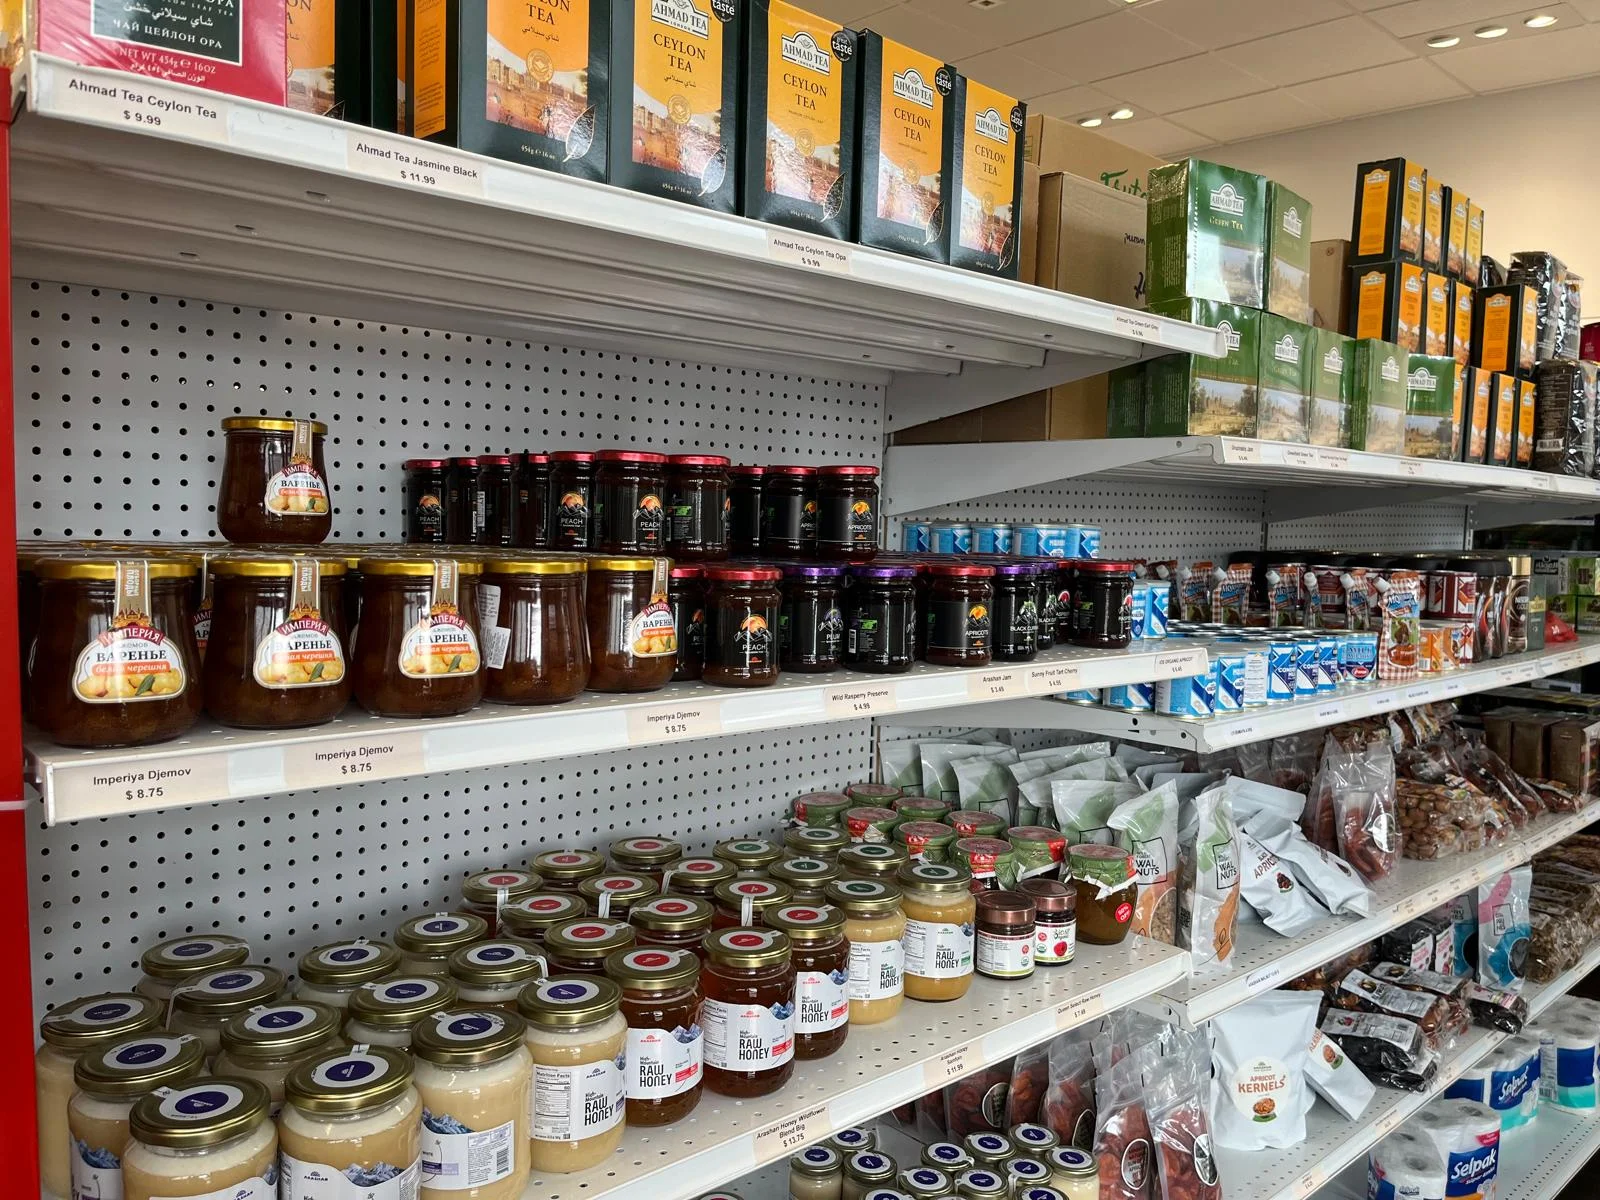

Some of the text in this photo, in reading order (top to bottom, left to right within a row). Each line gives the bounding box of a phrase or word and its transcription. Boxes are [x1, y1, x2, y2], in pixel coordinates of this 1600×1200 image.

[524, 3, 556, 26] TEA
[653, 3, 708, 32] AHMAD TEA
[113, 19, 139, 32] ЧАЙ
[144, 26, 196, 43] ЦЕЙЛОН
[653, 33, 707, 61] CEYLON
[831, 41, 853, 56] taste
[141, 51, 156, 62] WT
[783, 42, 829, 69] AHMAD TEA
[667, 54, 693, 73] TEA
[783, 73, 828, 98] CEYLON
[935, 76, 952, 90] taste
[69, 78, 217, 119] Ahmad Tea Ceylon Tea
[894, 80, 932, 102] AHMAD TEA
[794, 93, 817, 112] TEA
[123, 109, 162, 126] $ 9.99
[893, 107, 931, 130] CEYLON
[903, 125, 921, 143] TEA
[976, 117, 1008, 139] AHMAD TEA
[356, 143, 478, 179] Ahmad Tea Jasmine Black
[975, 144, 1006, 165] CEYLON
[983, 162, 998, 177] TEA
[400, 169, 436, 186] $ 11.99
[773, 238, 847, 263] Ahmad Tea Ceylon Tea Opa
[560, 517, 583, 525] PEACH
[283, 619, 328, 635] ИМПЕРИЯ
[1002, 674, 1012, 682] Jam
[1032, 670, 1044, 678] Sunny
[1045, 669, 1055, 677] Fruit
[1064, 667, 1078, 677] Cherry
[868, 690, 888, 698] Preserve
[647, 710, 701, 722] Imperiya Djemov
[665, 724, 687, 734] $ 8.75
[315, 745, 394, 762] Imperiya Djemov
[341, 763, 372, 775] $ 8.75
[93, 767, 191, 787] Imperiya Djemov
[126, 787, 164, 801] $ 8.75
[1136, 860, 1156, 868] WAL
[1136, 867, 1160, 876] NUTS
[1219, 861, 1234, 871] WAL
[1220, 868, 1237, 881] NUTS
[935, 959, 959, 969] HONEY
[936, 951, 955, 962] RAW
[880, 969, 896, 980] RAW
[880, 977, 900, 990] HONEY
[801, 1002, 823, 1014] RAW
[801, 1010, 829, 1024] HONEY
[739, 1038, 762, 1049] RAW
[739, 1047, 769, 1060] HONEY
[640, 1064, 664, 1076] RAW
[639, 1073, 672, 1088] HONEY
[1250, 1074, 1276, 1082] APRICOT
[1238, 1079, 1285, 1093] KERNELS
[585, 1096, 608, 1114] RAW
[584, 1104, 614, 1126] HONEY
[757, 1106, 826, 1140] Arashan Honey Wildflower
[779, 1124, 805, 1138] Blend Big
[789, 1133, 805, 1145] 13.75
[1451, 1148, 1497, 1180] Selpak
